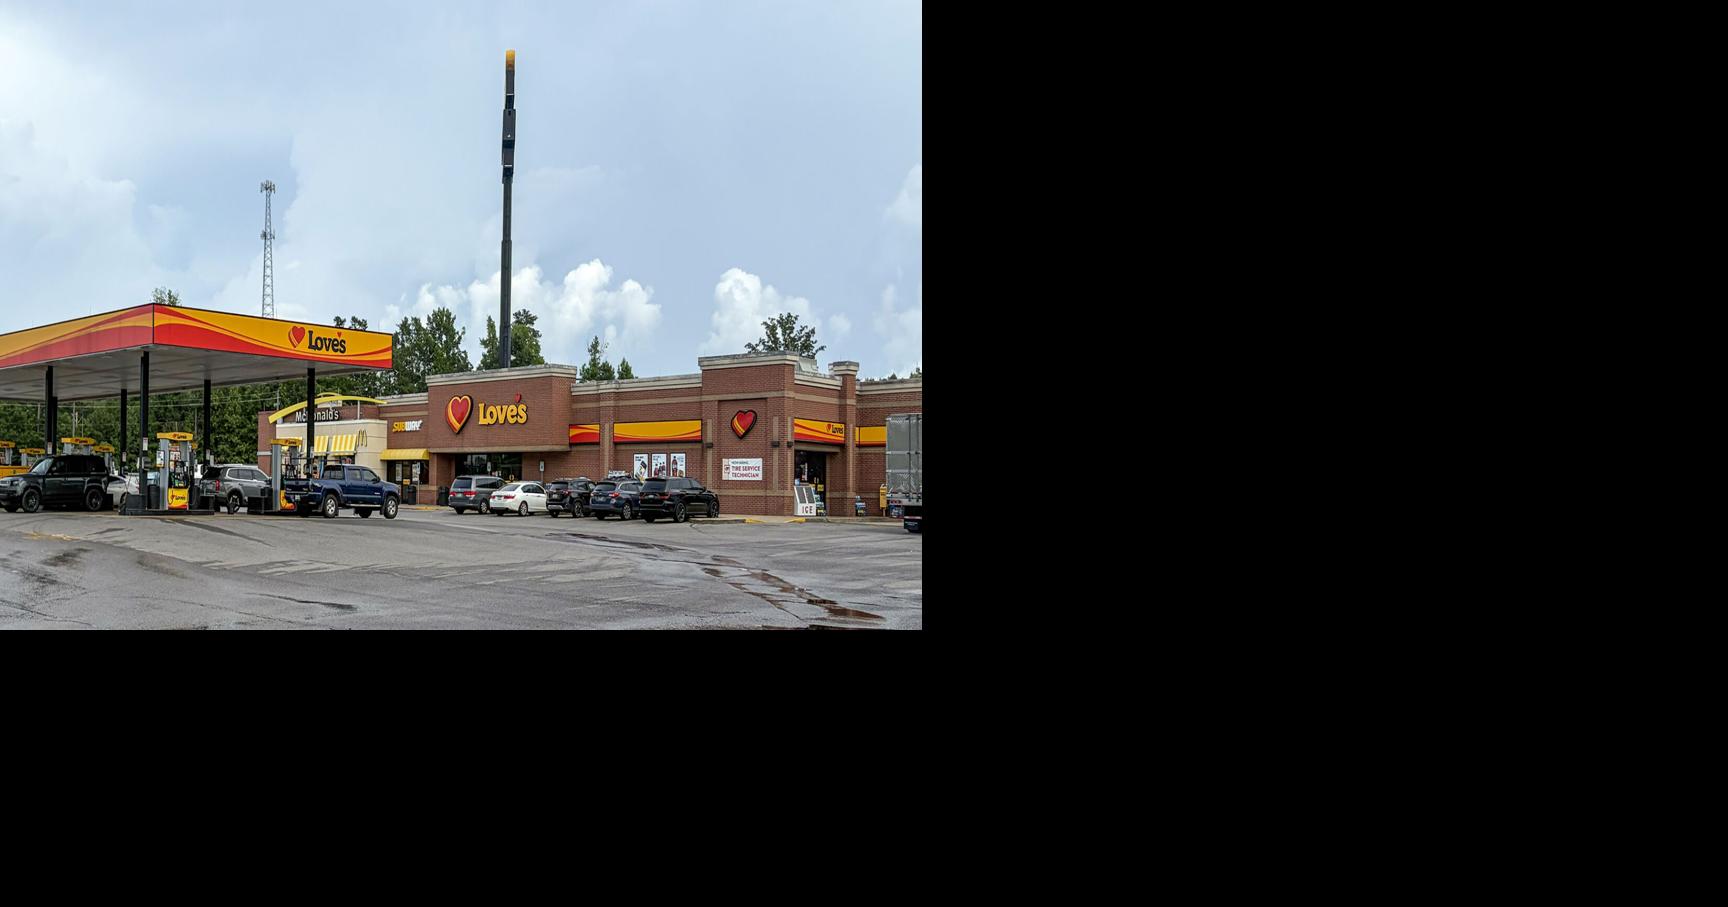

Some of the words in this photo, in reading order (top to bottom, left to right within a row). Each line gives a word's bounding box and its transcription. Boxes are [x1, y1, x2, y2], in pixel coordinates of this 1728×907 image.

[295, 409, 339, 422] Mcnald's
[392, 420, 423, 432] SUBWAY
[802, 506, 813, 514] ICE
